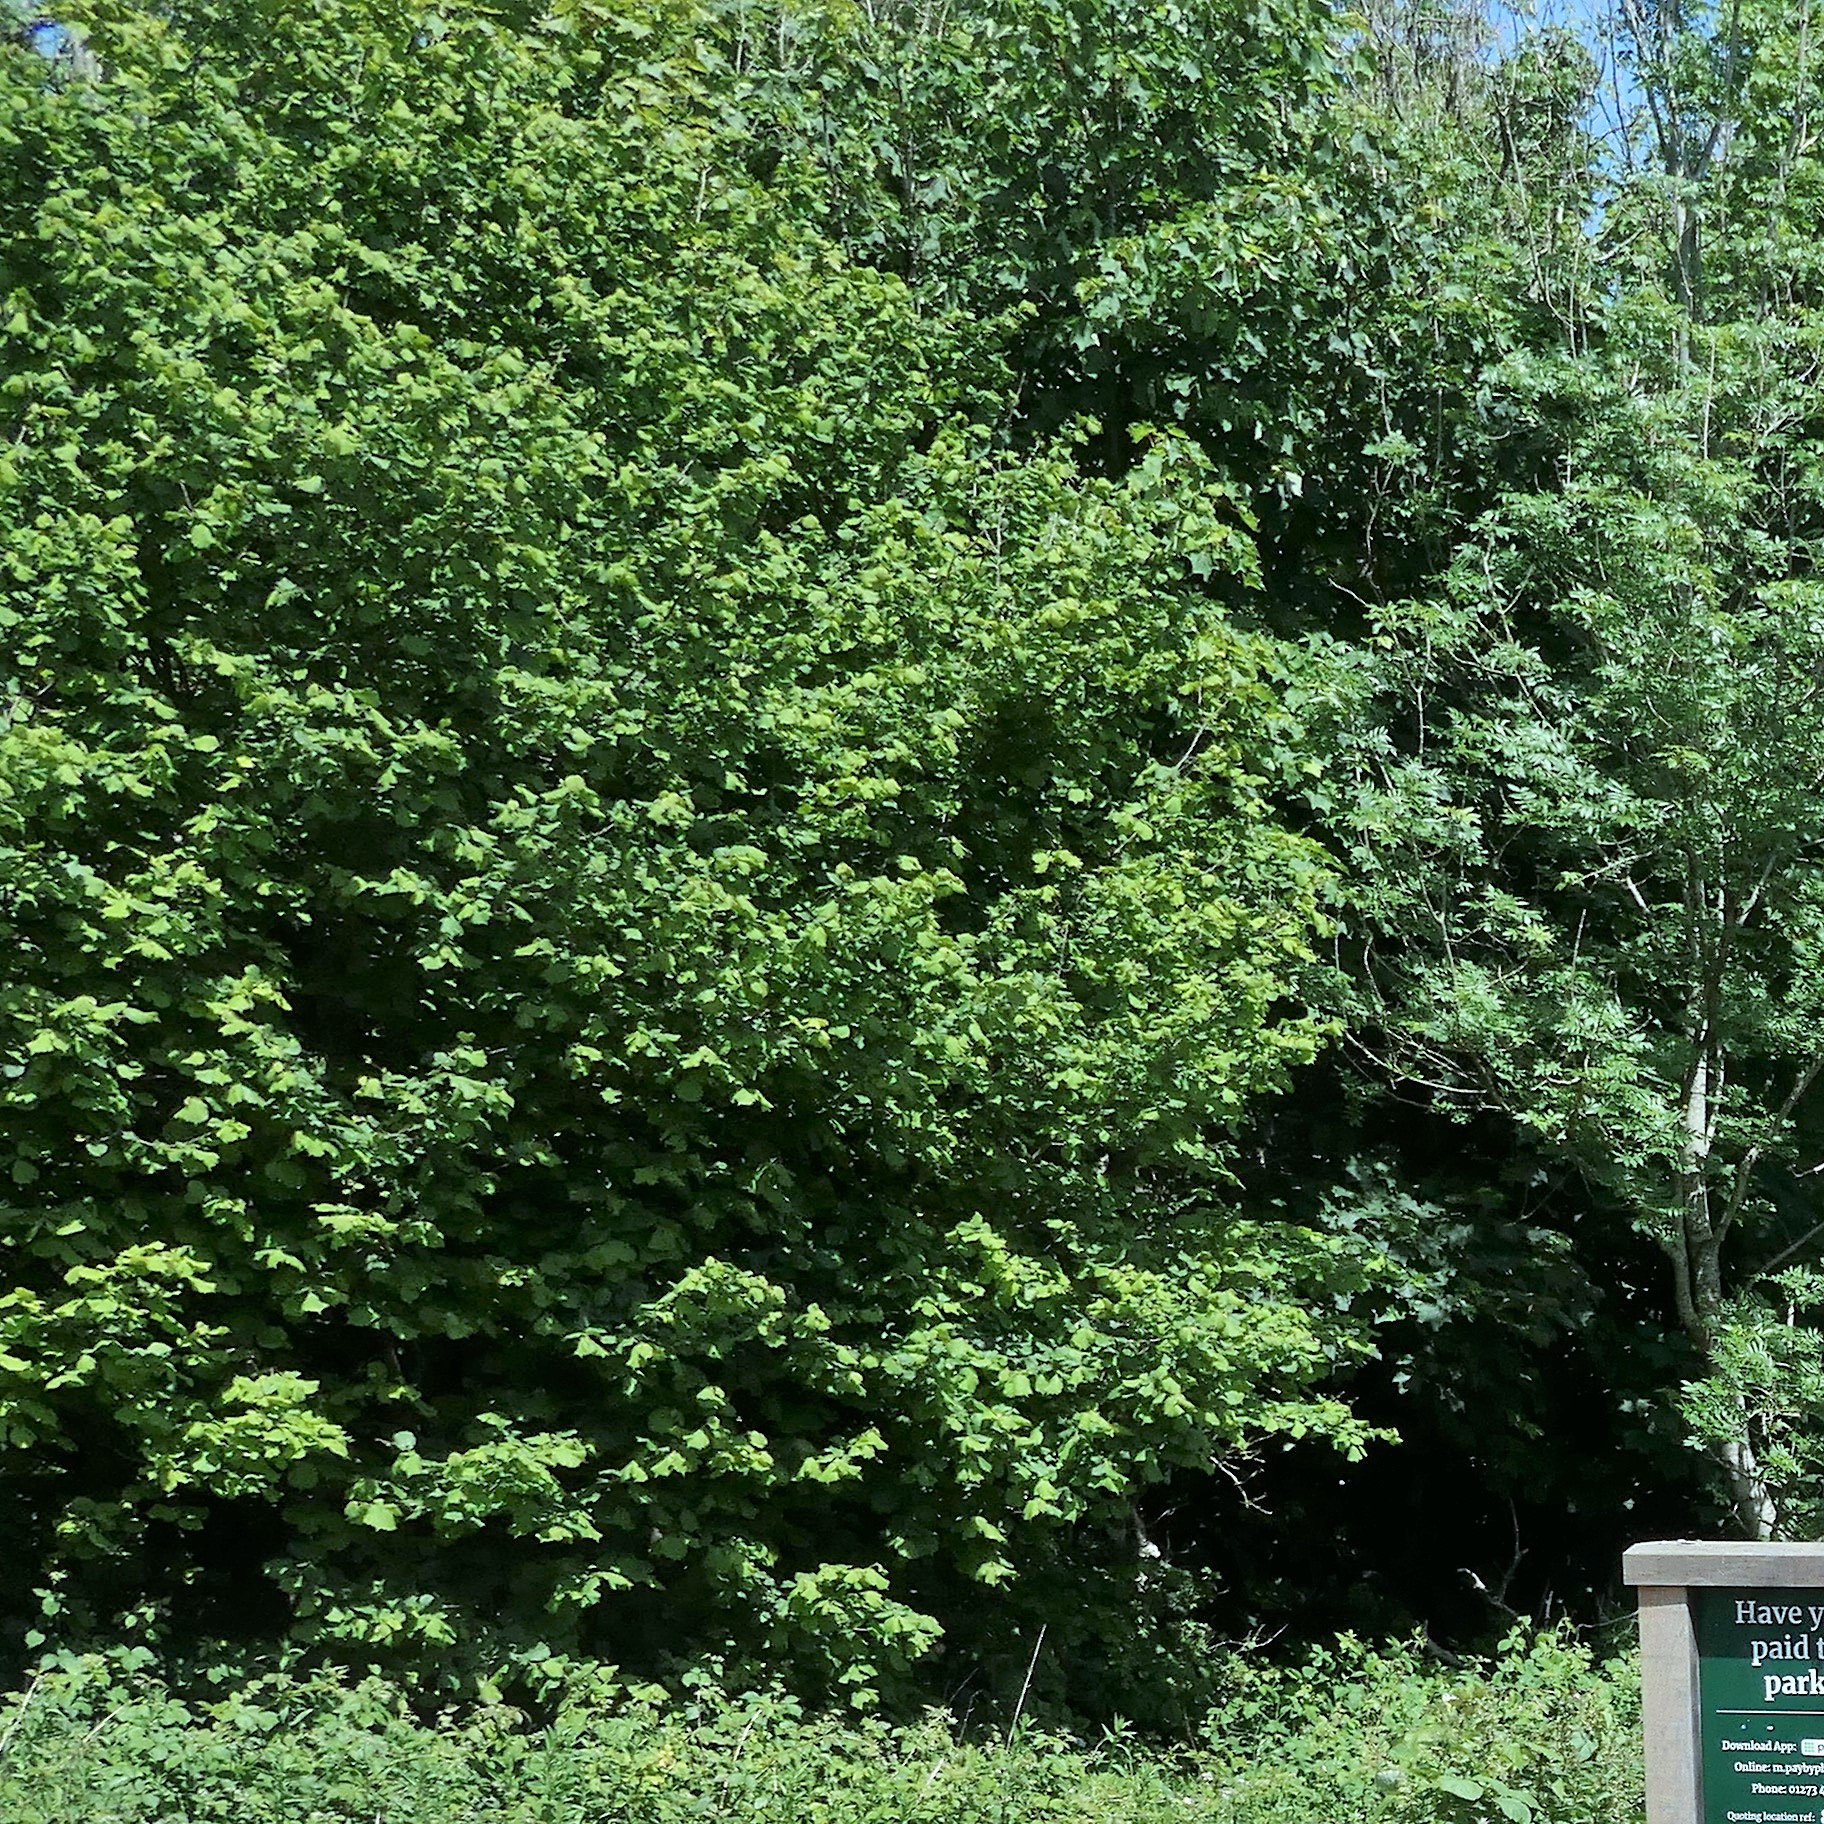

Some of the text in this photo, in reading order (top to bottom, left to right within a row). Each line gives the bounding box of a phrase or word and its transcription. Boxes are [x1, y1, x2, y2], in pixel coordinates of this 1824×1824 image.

[1735, 1600, 1802, 1624] Have
[1751, 1634, 1810, 1667] paid
[1722, 1740, 1797, 1754] Download App:
[1734, 1761, 1771, 1773] Online:
[1752, 1783, 1787, 1794] Phone:
[1788, 1785, 1818, 1796] 01273
[1727, 1811, 1762, 1823] Quoting
[1763, 1811, 1798, 1822] location
[1799, 1812, 1816, 1822] ref:
